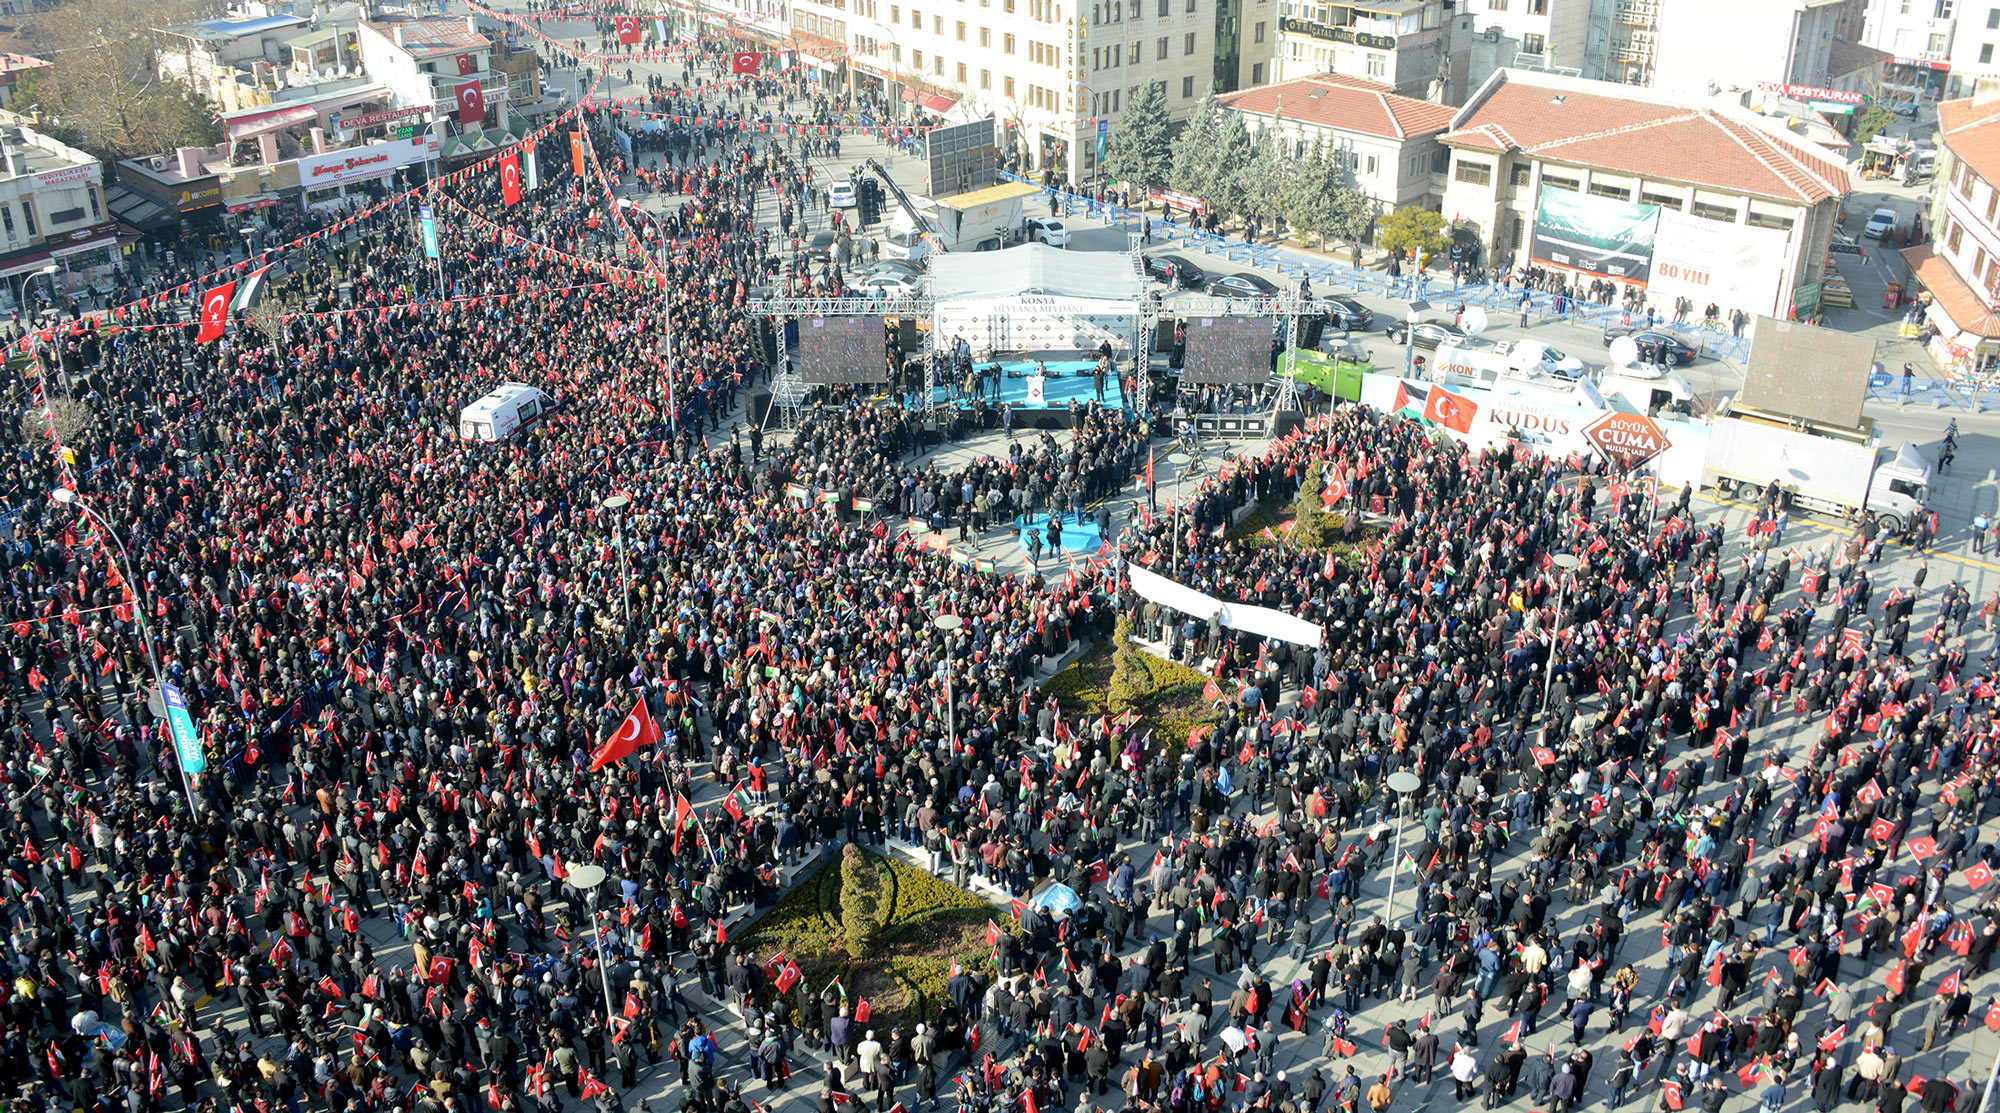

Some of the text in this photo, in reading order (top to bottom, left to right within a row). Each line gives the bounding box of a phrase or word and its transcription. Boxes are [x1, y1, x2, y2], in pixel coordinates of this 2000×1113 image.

[1360, 35, 1393, 47] OTEL
[434, 102, 455, 113] DEVA
[343, 106, 428, 127] DEVA RESTAURANT
[1021, 297, 1055, 305] KONYA
[1490, 408, 1570, 435] KUDÜS
[1610, 419, 1649, 434] BÜYÜK
[1597, 428, 1658, 451] CUMA
